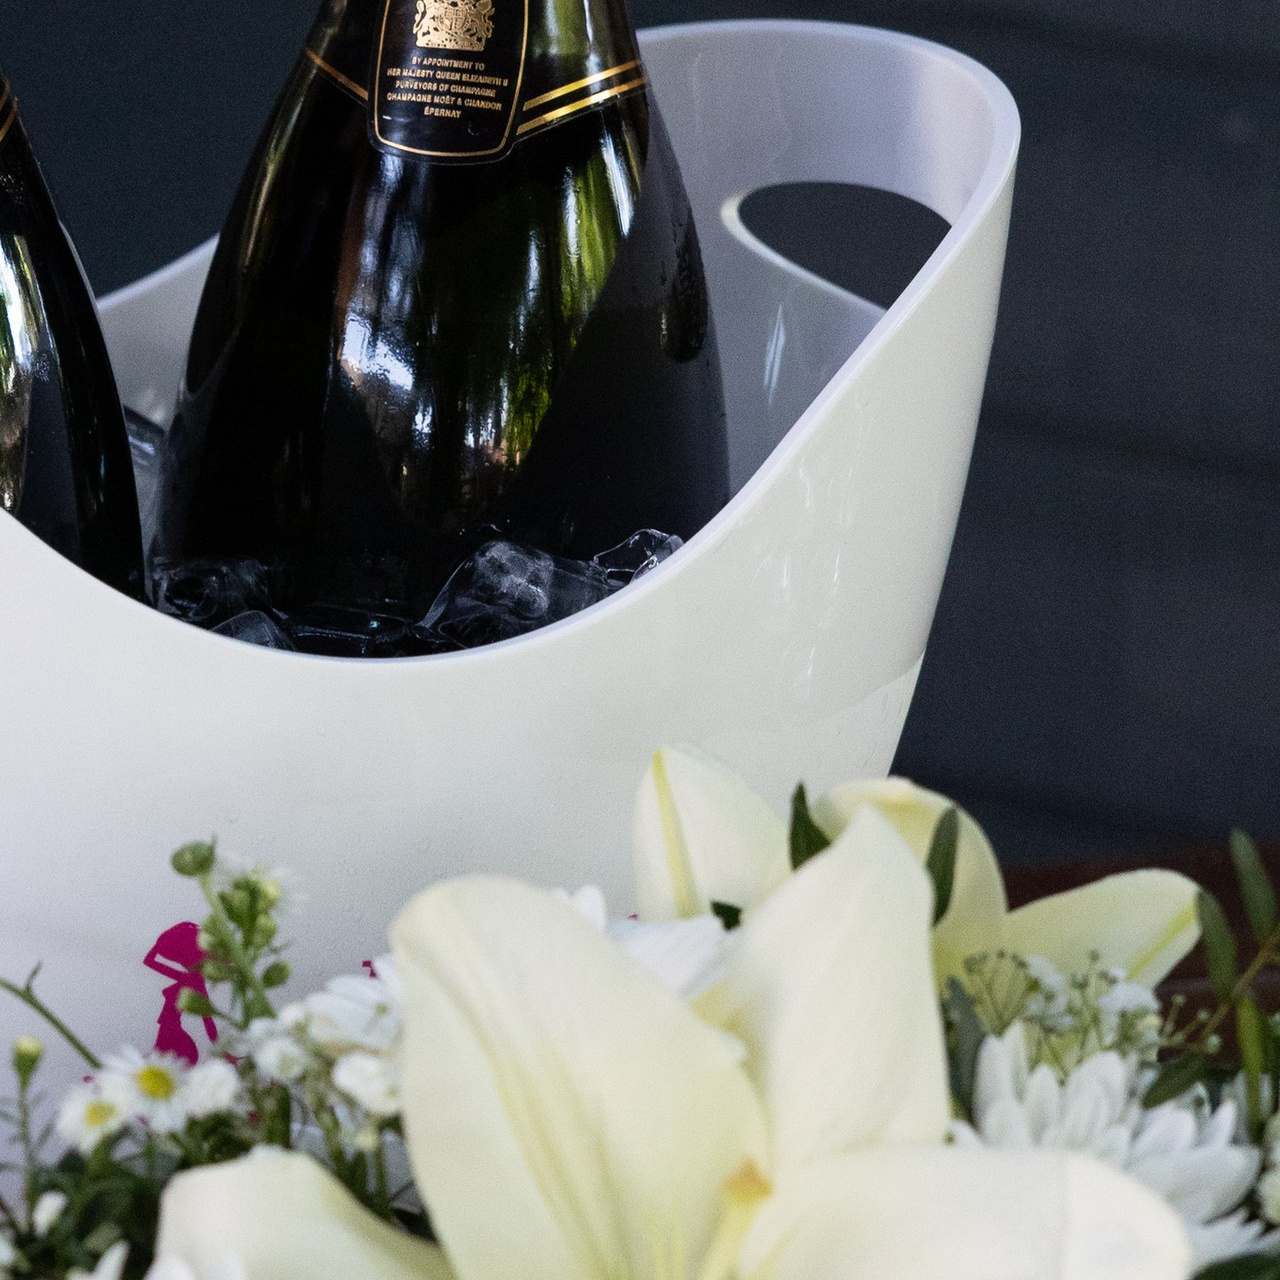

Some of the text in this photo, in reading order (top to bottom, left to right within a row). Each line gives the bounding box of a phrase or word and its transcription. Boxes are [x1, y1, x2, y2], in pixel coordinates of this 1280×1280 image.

[412, 56, 485, 71] BY APPOINTMENT TO
[387, 68, 401, 77] HER
[402, 68, 434, 77] MAJESTY
[436, 71, 461, 81] QUEEN
[395, 80, 496, 98] PURVEYORS OF CHAMPAGNE
[387, 92, 432, 103] CHAMPAGNE
[464, 98, 502, 111] CHANDON
[424, 105, 461, 119] ÉPERNAY
